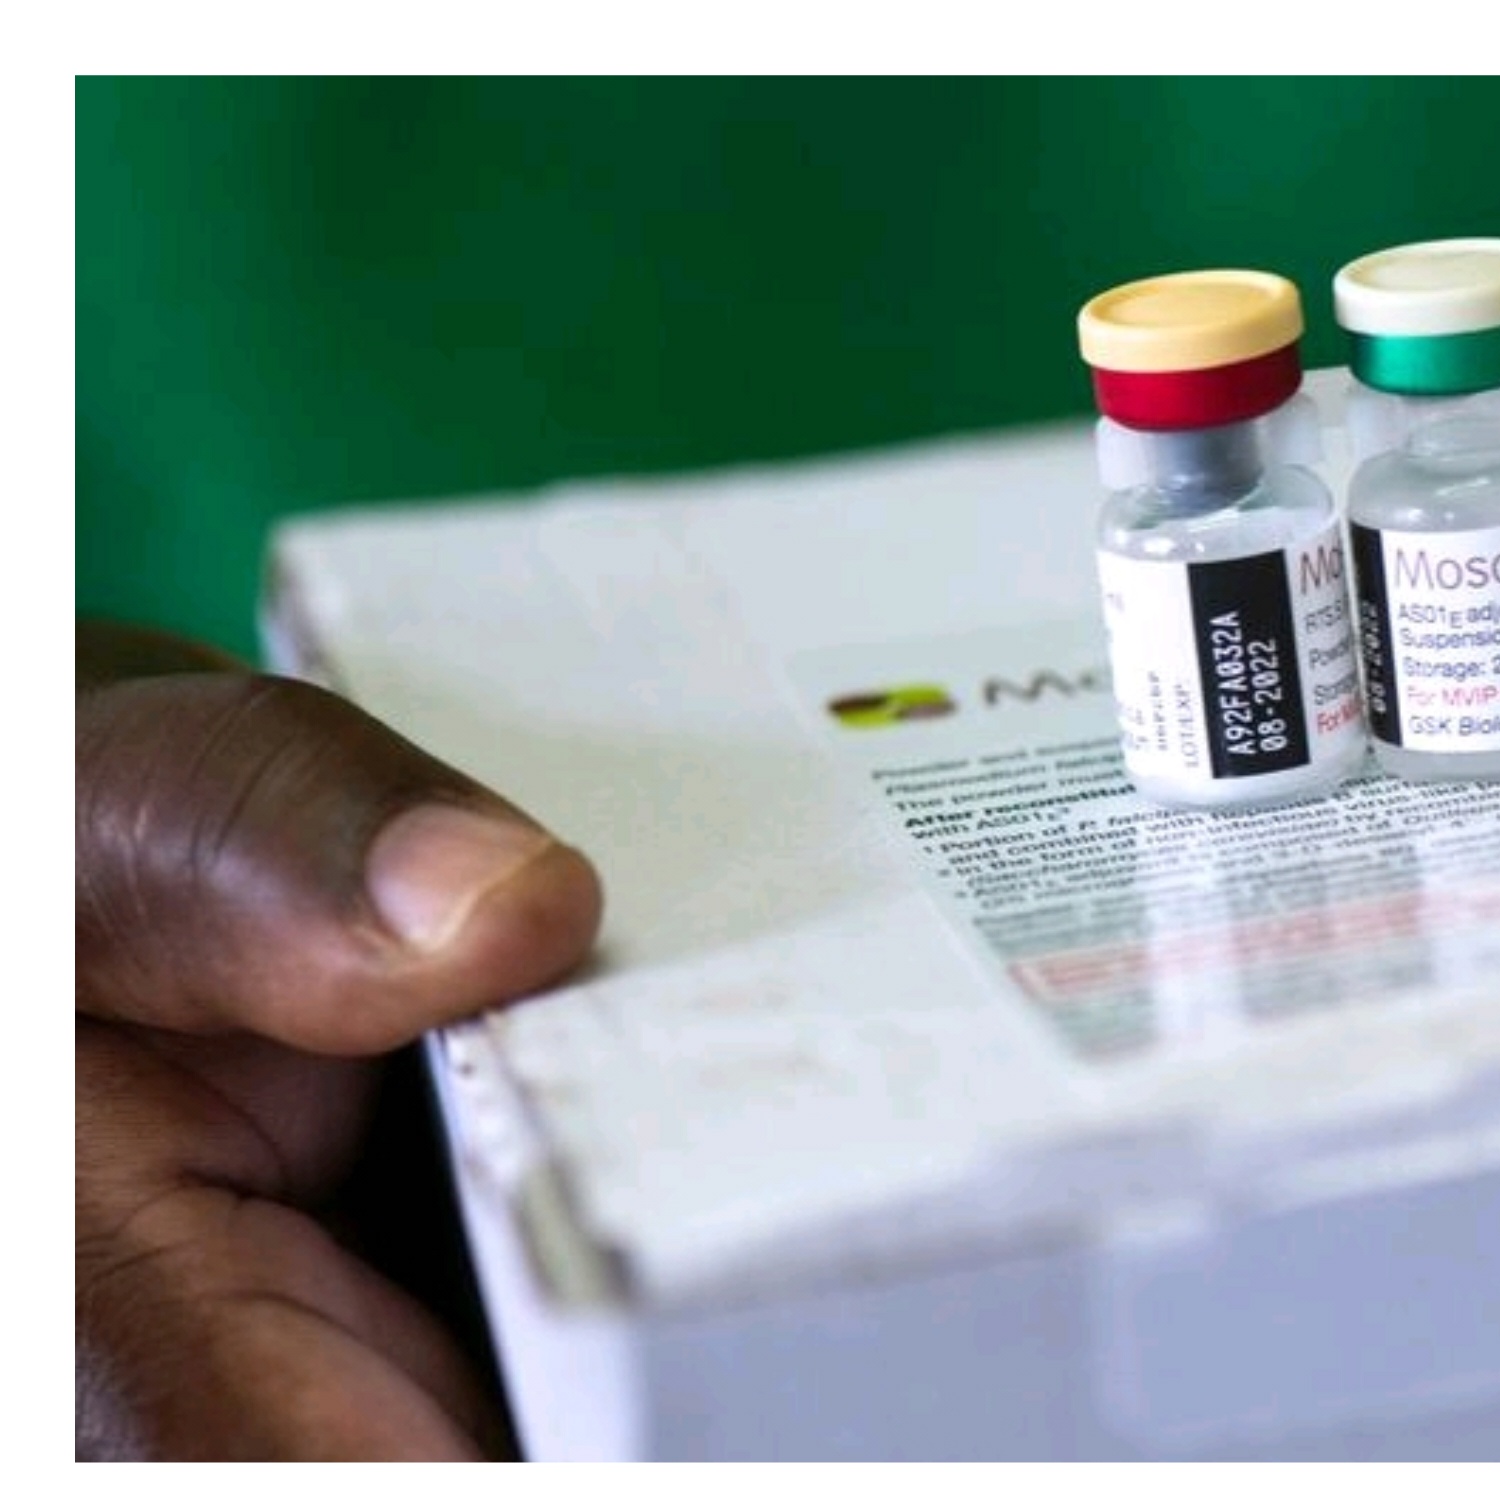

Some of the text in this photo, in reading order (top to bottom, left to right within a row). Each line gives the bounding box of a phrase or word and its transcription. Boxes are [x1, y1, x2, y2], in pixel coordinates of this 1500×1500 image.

[1208, 609, 1257, 755] A92FA032A
[1402, 655, 1486, 683] Storage:
[1246, 638, 1288, 752] 08-2022
[1406, 686, 1436, 710] For
[1441, 685, 1499, 707] MVIP
[1408, 715, 1452, 736] GSK
